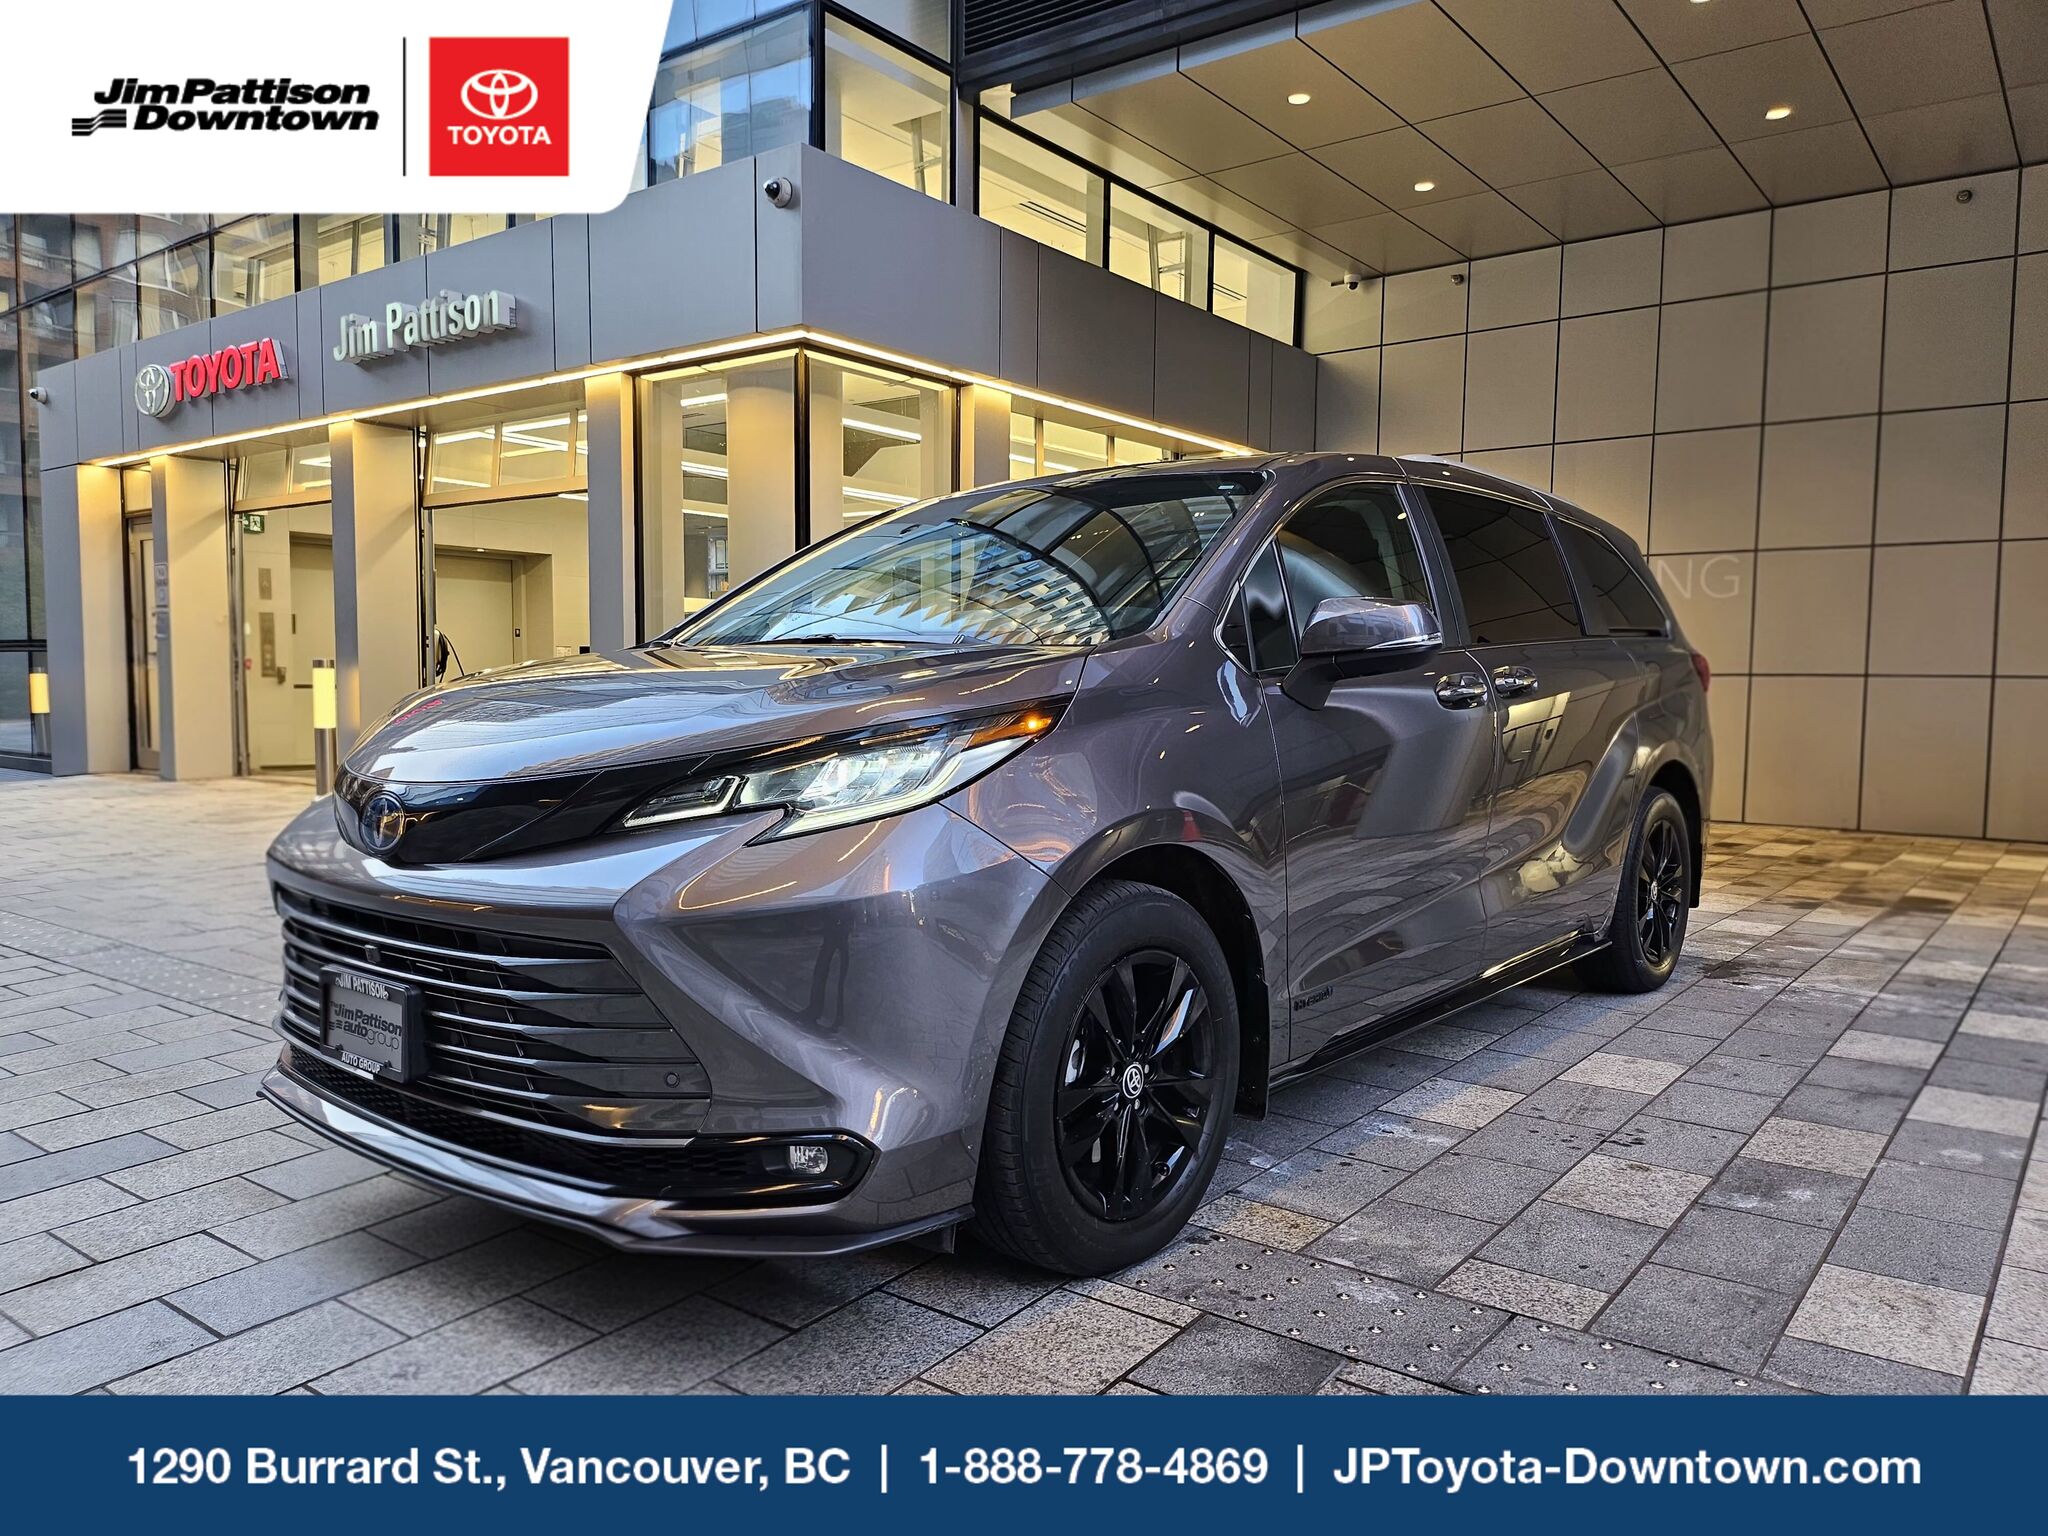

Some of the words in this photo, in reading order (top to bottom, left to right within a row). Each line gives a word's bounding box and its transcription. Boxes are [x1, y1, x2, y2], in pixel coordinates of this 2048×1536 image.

[332, 313, 378, 362] Jim
[386, 287, 500, 350] Pattison
[169, 336, 281, 402] TOYOTA
[1655, 555, 1741, 599] NG
[353, 976, 386, 999] PATTISON
[341, 1051, 358, 1067] AUTO
[358, 1057, 381, 1074] GROUP
